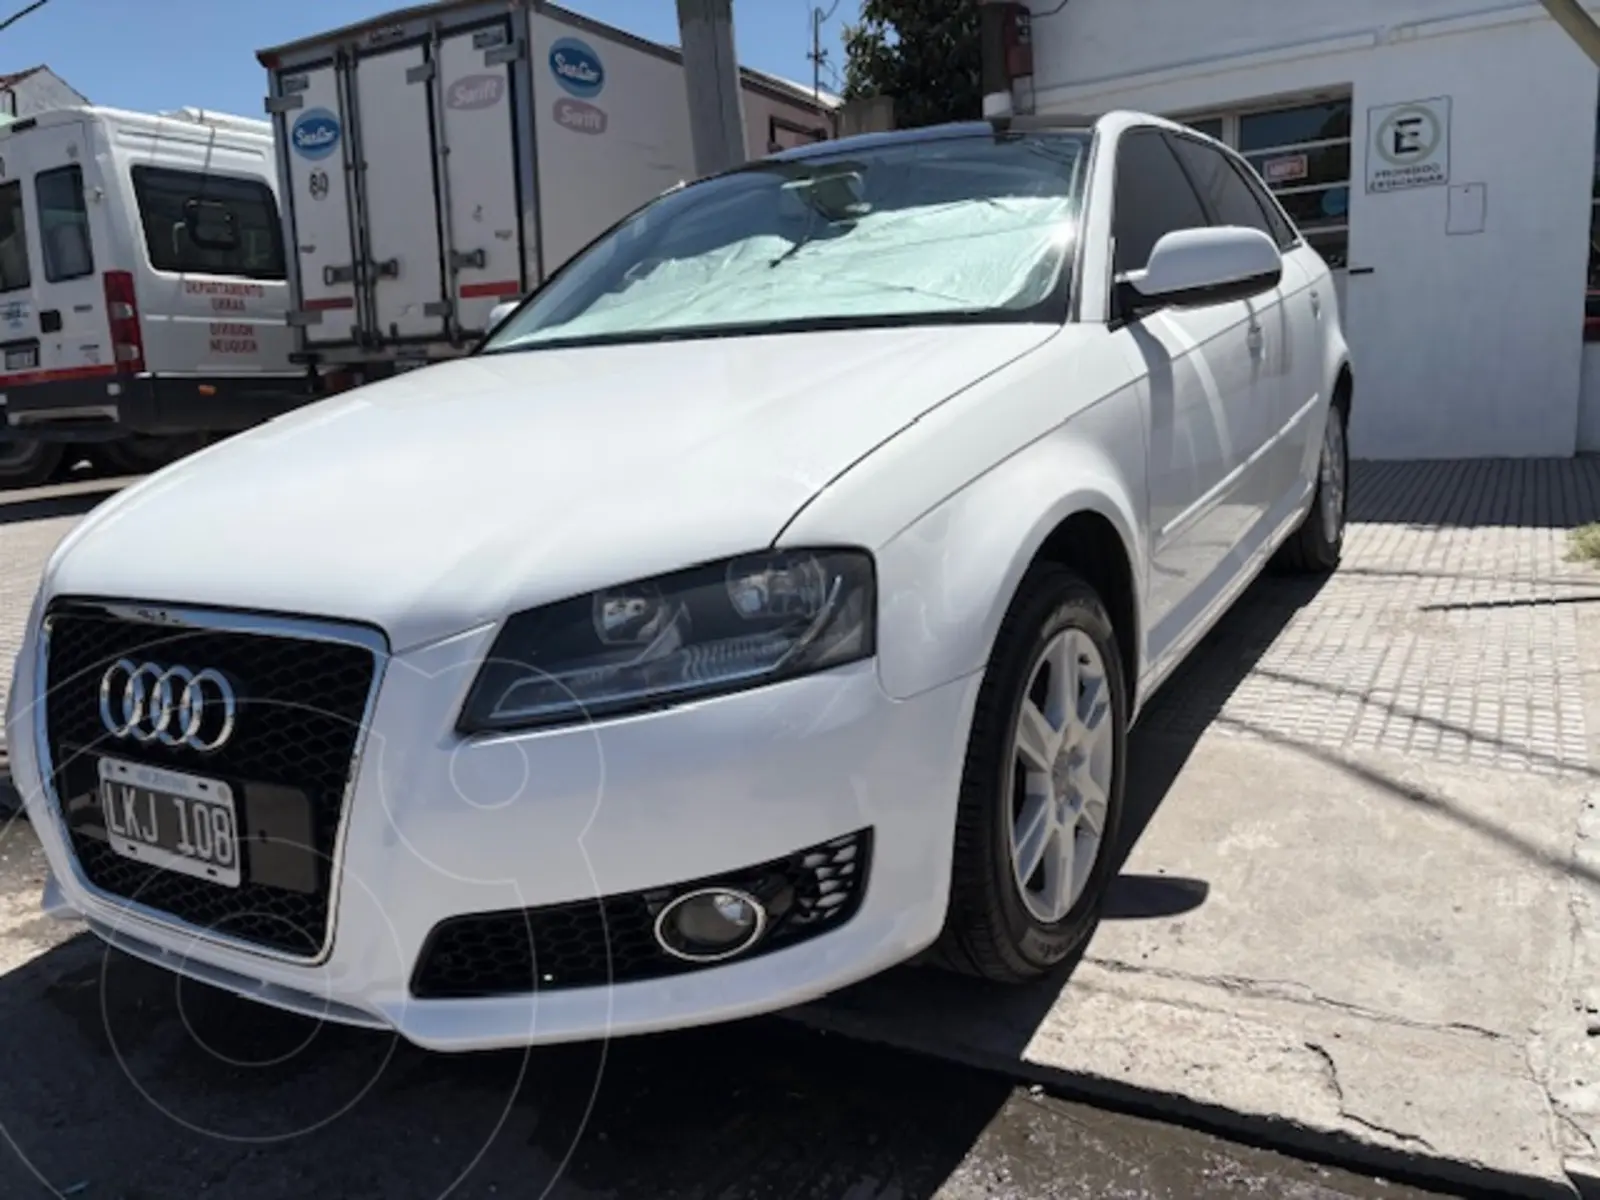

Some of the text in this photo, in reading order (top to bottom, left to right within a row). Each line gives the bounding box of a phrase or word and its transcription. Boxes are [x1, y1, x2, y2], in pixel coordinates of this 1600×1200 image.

[453, 80, 498, 107] Swift
[560, 105, 600, 129] Swift
[1395, 117, 1422, 154] E
[184, 280, 265, 298] DEPARTAMENTO
[104, 782, 233, 865] LKJ 108
